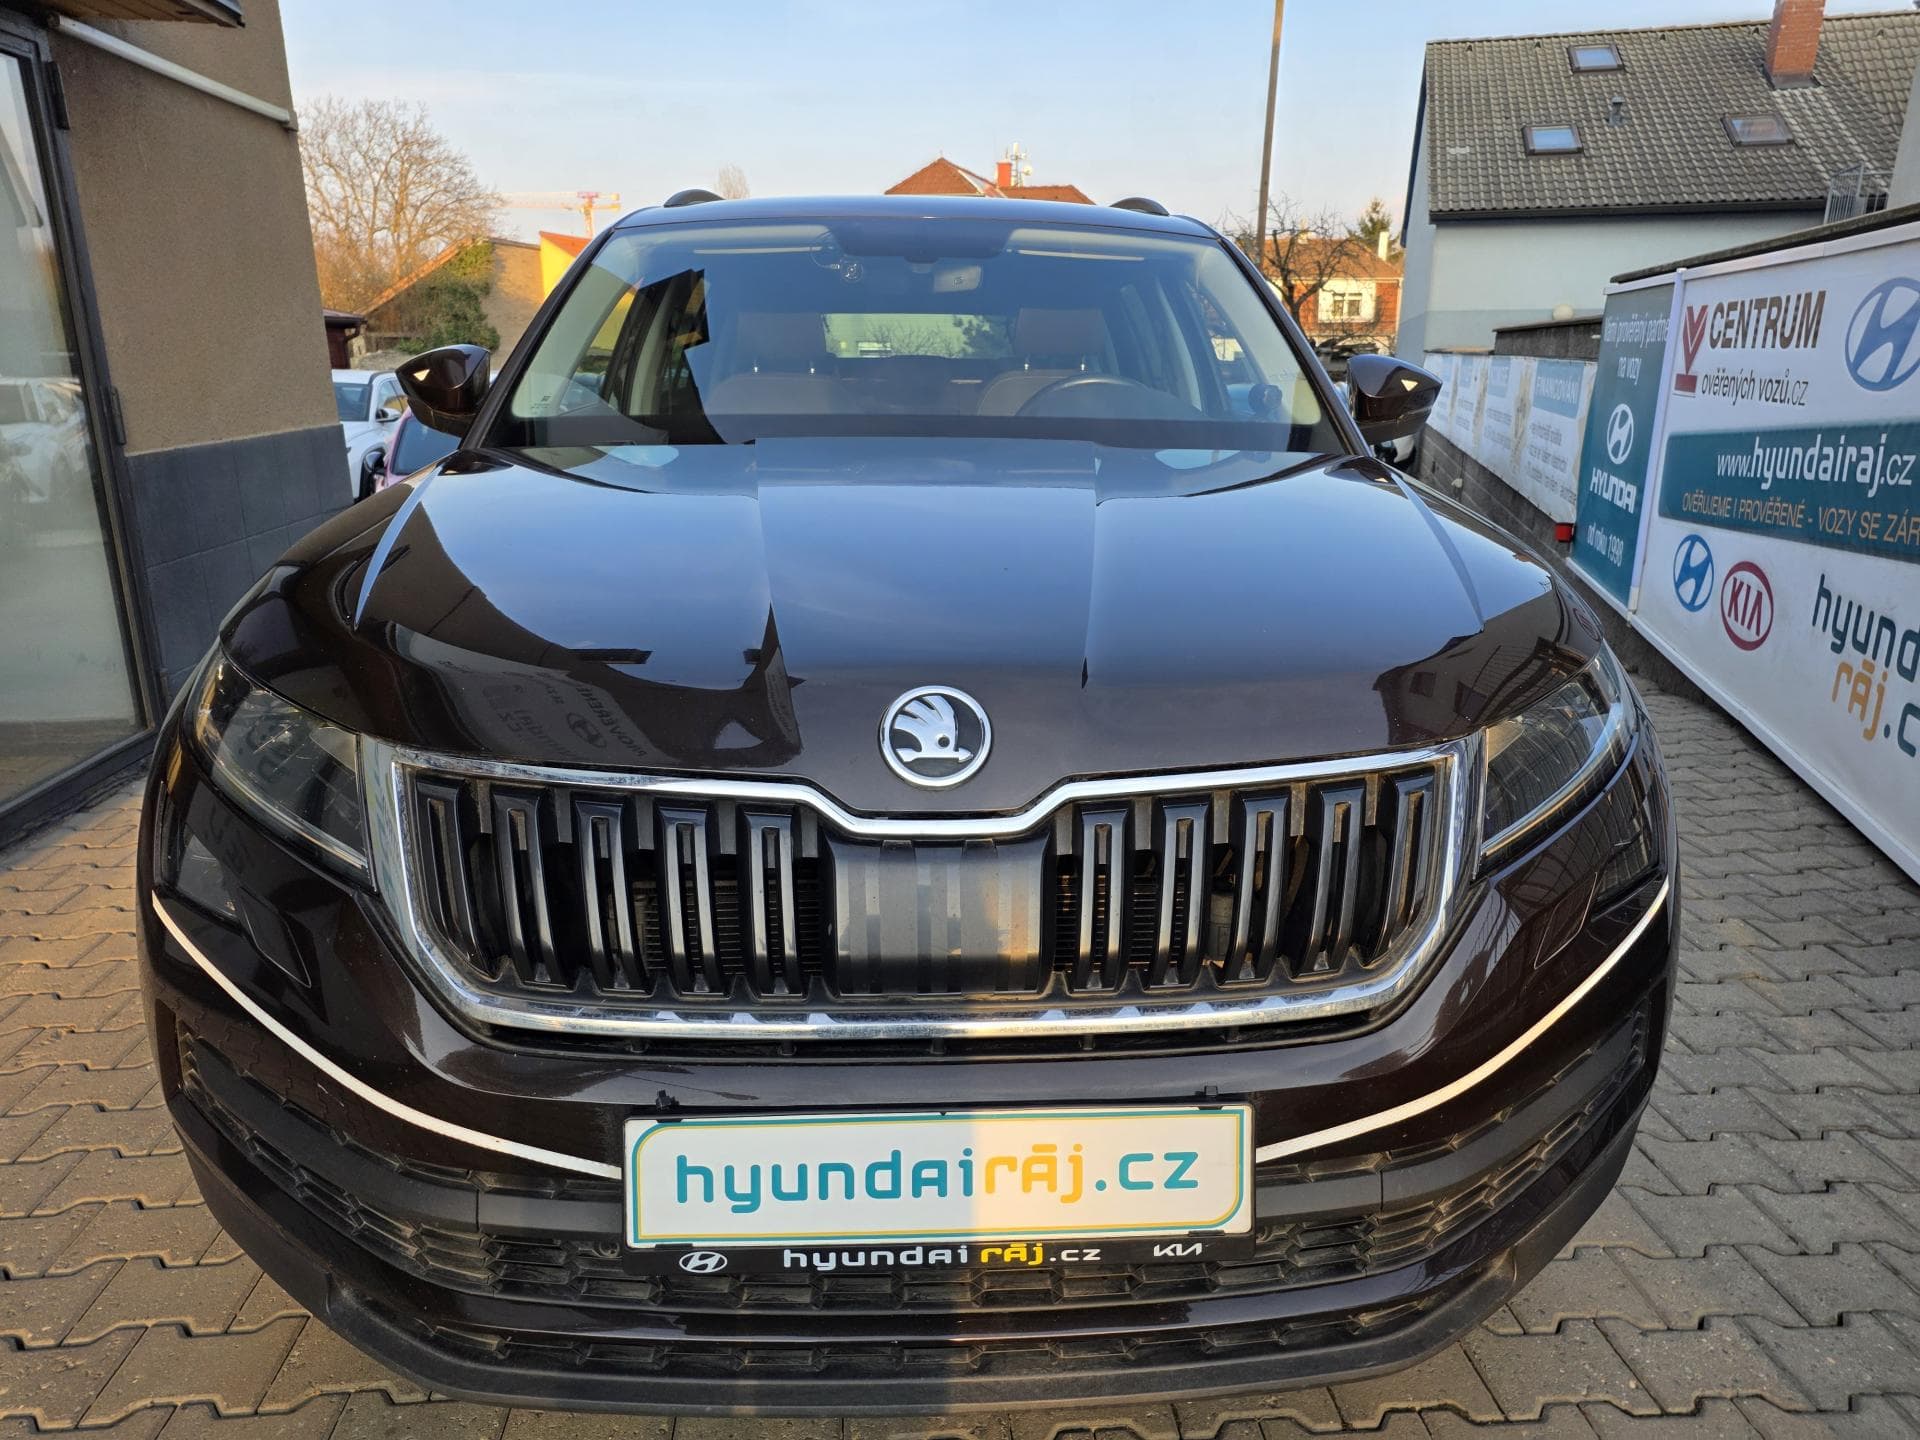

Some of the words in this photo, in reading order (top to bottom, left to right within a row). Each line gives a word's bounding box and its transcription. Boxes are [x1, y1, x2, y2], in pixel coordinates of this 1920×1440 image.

[1709, 290, 1827, 350] CENTRUM
[1701, 367, 1756, 406] ověřených
[1758, 368, 1809, 406] vozů.cz
[1590, 467, 1637, 514] HYUNDAI
[1717, 432, 1916, 498] www.hyundairaj.cz
[1738, 495, 1806, 529] PROVĚŘENÉ
[1818, 506, 1857, 536] VOZY
[1858, 511, 1882, 540] SE
[1727, 577, 1763, 637] KIA
